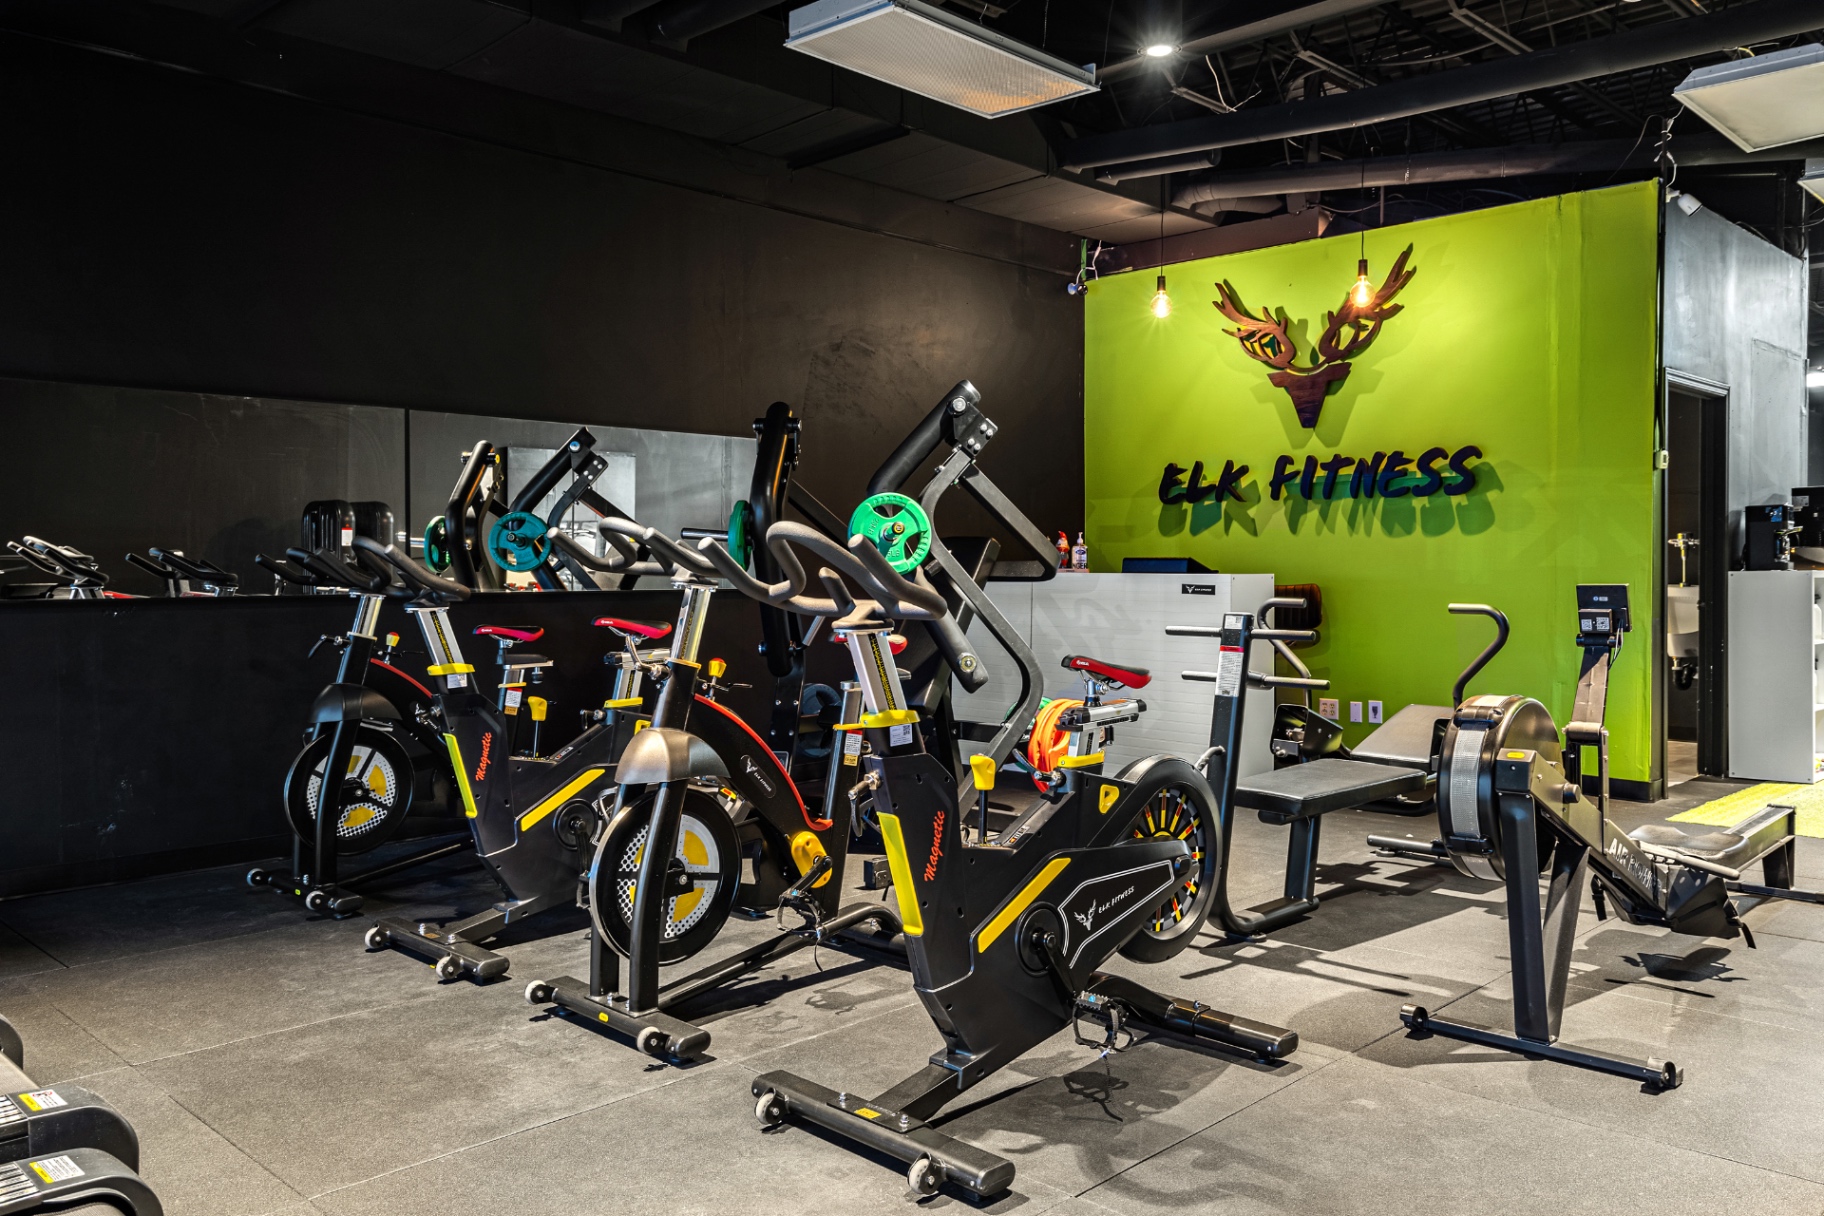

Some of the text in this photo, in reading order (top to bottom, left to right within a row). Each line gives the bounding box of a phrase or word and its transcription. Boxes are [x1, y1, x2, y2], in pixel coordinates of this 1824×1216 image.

[1159, 445, 1483, 505] ELK FITNESS
[475, 732, 492, 781] Magnetic
[924, 810, 945, 882] Magnetic
